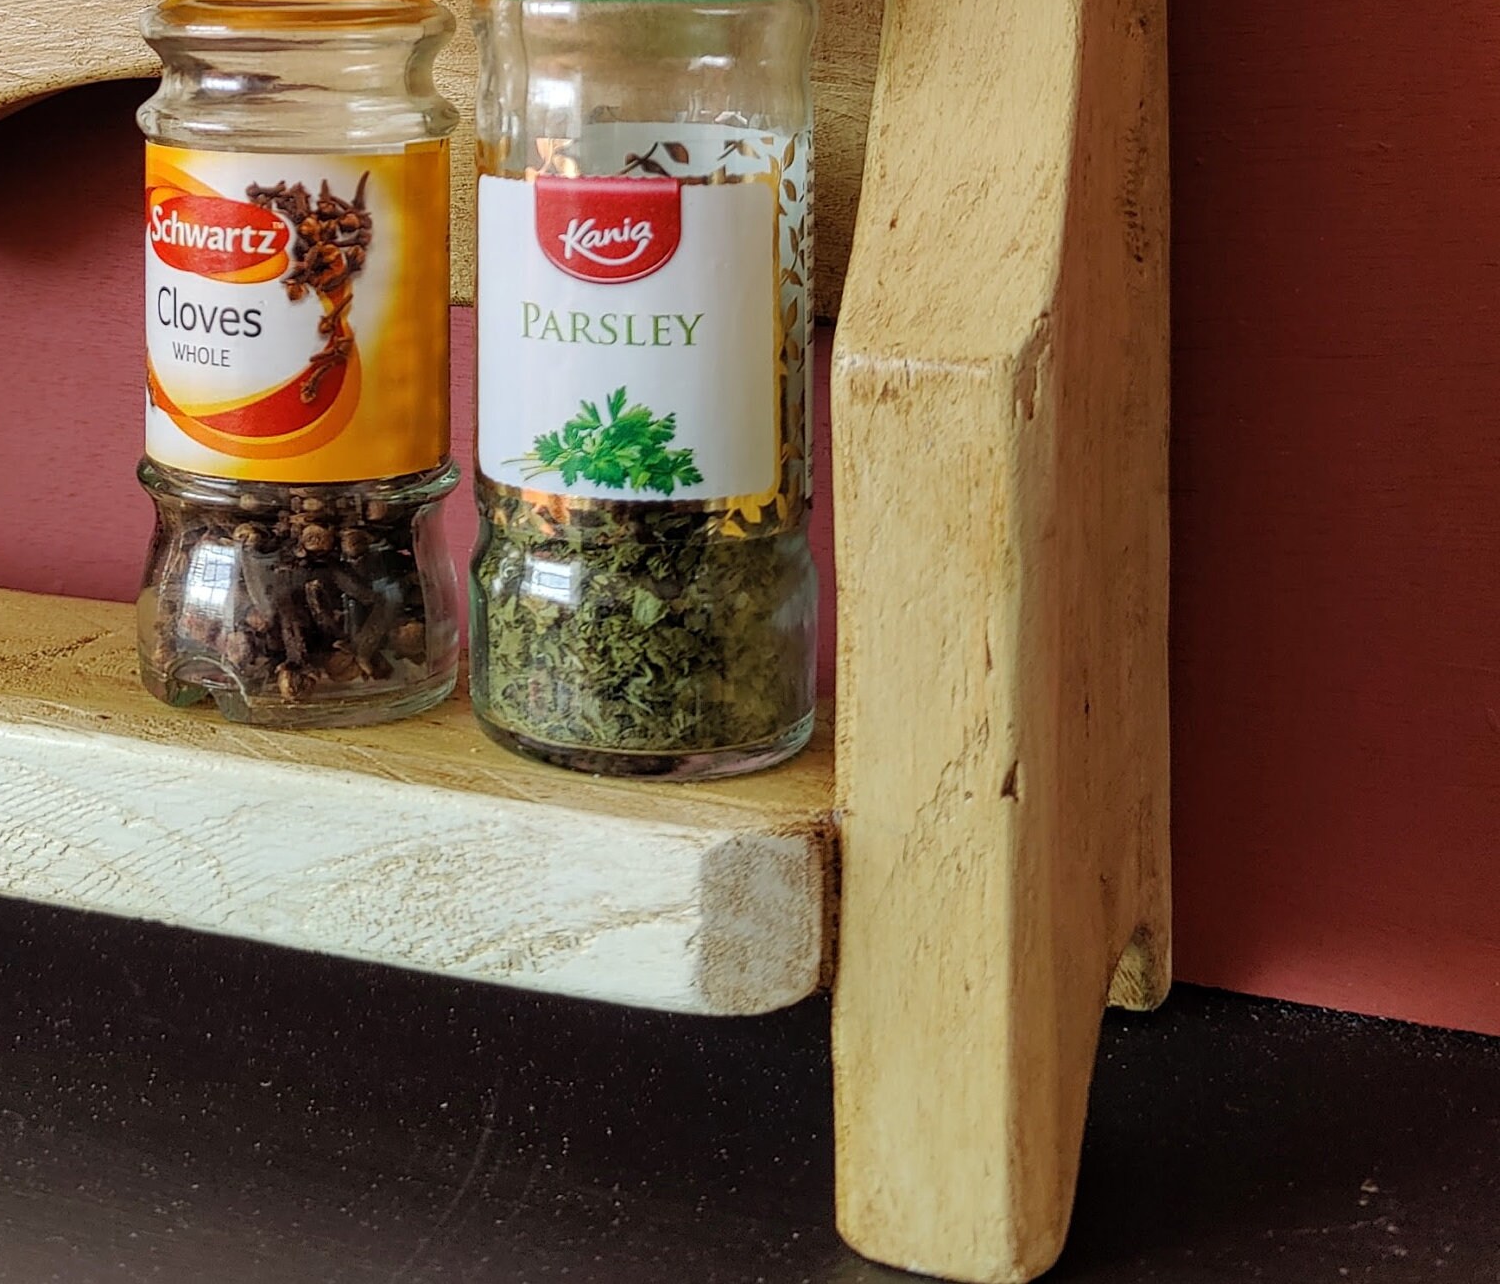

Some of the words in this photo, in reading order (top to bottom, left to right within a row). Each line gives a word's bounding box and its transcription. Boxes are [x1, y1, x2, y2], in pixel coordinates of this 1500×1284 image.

[152, 205, 277, 254] Schwartz
[558, 217, 654, 266] Kania
[157, 286, 262, 337] Cloves
[520, 301, 705, 346] PARSLEY
[172, 341, 231, 367] WHOLE
